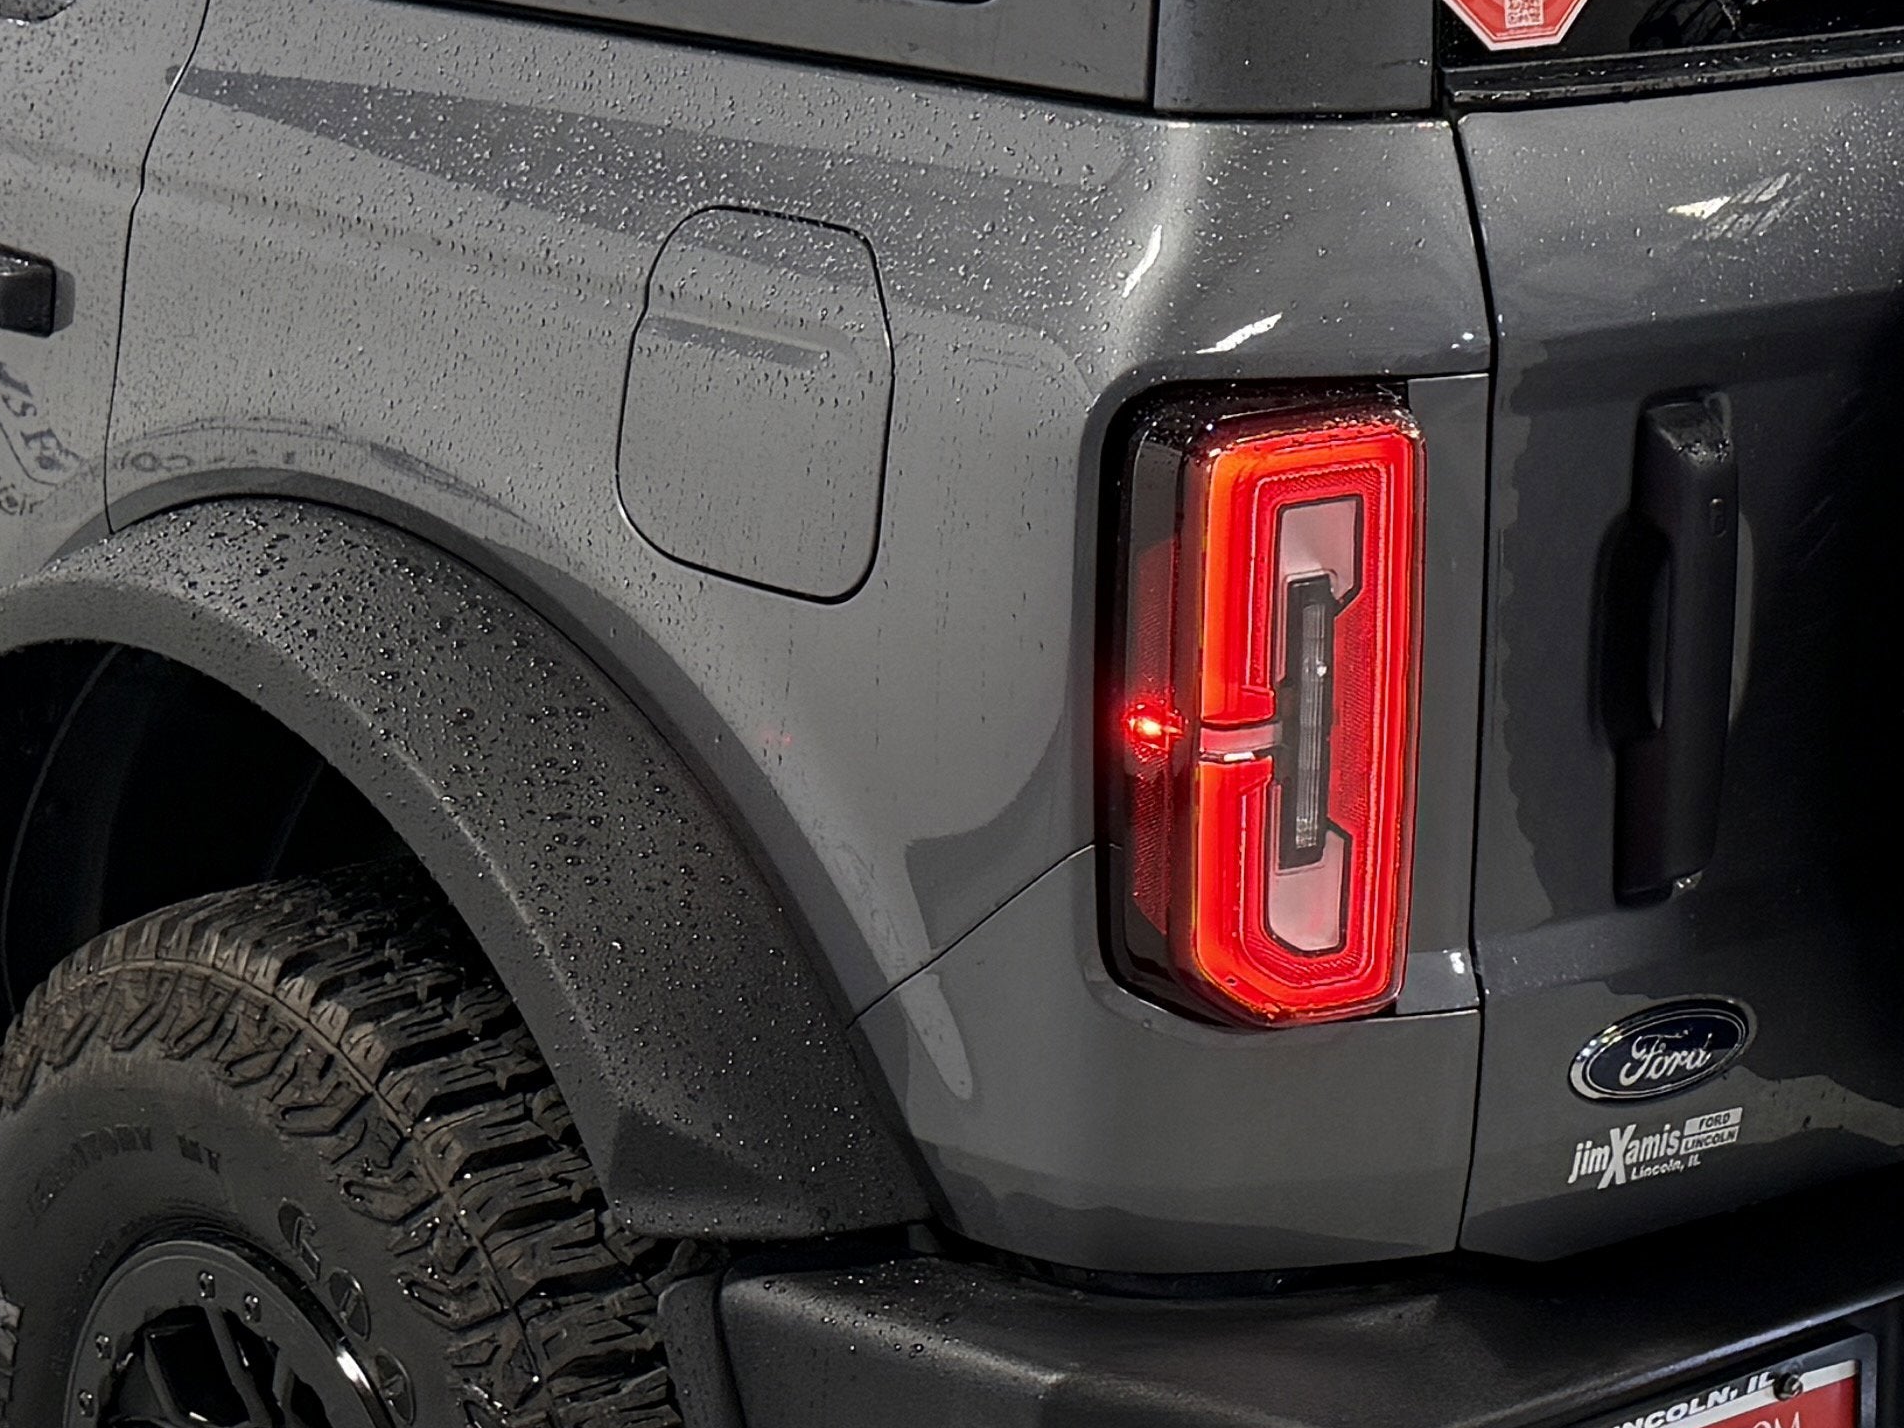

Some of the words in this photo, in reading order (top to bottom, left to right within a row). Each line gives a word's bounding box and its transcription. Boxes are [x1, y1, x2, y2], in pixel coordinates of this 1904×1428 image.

[1699, 1112, 1731, 1131] FORD
[1684, 1130, 1737, 1152] LINCOLN
[1631, 1157, 1684, 1181] Lincoln,
[1688, 1154, 1701, 1168] IL
[1747, 1371, 1776, 1392] IL
